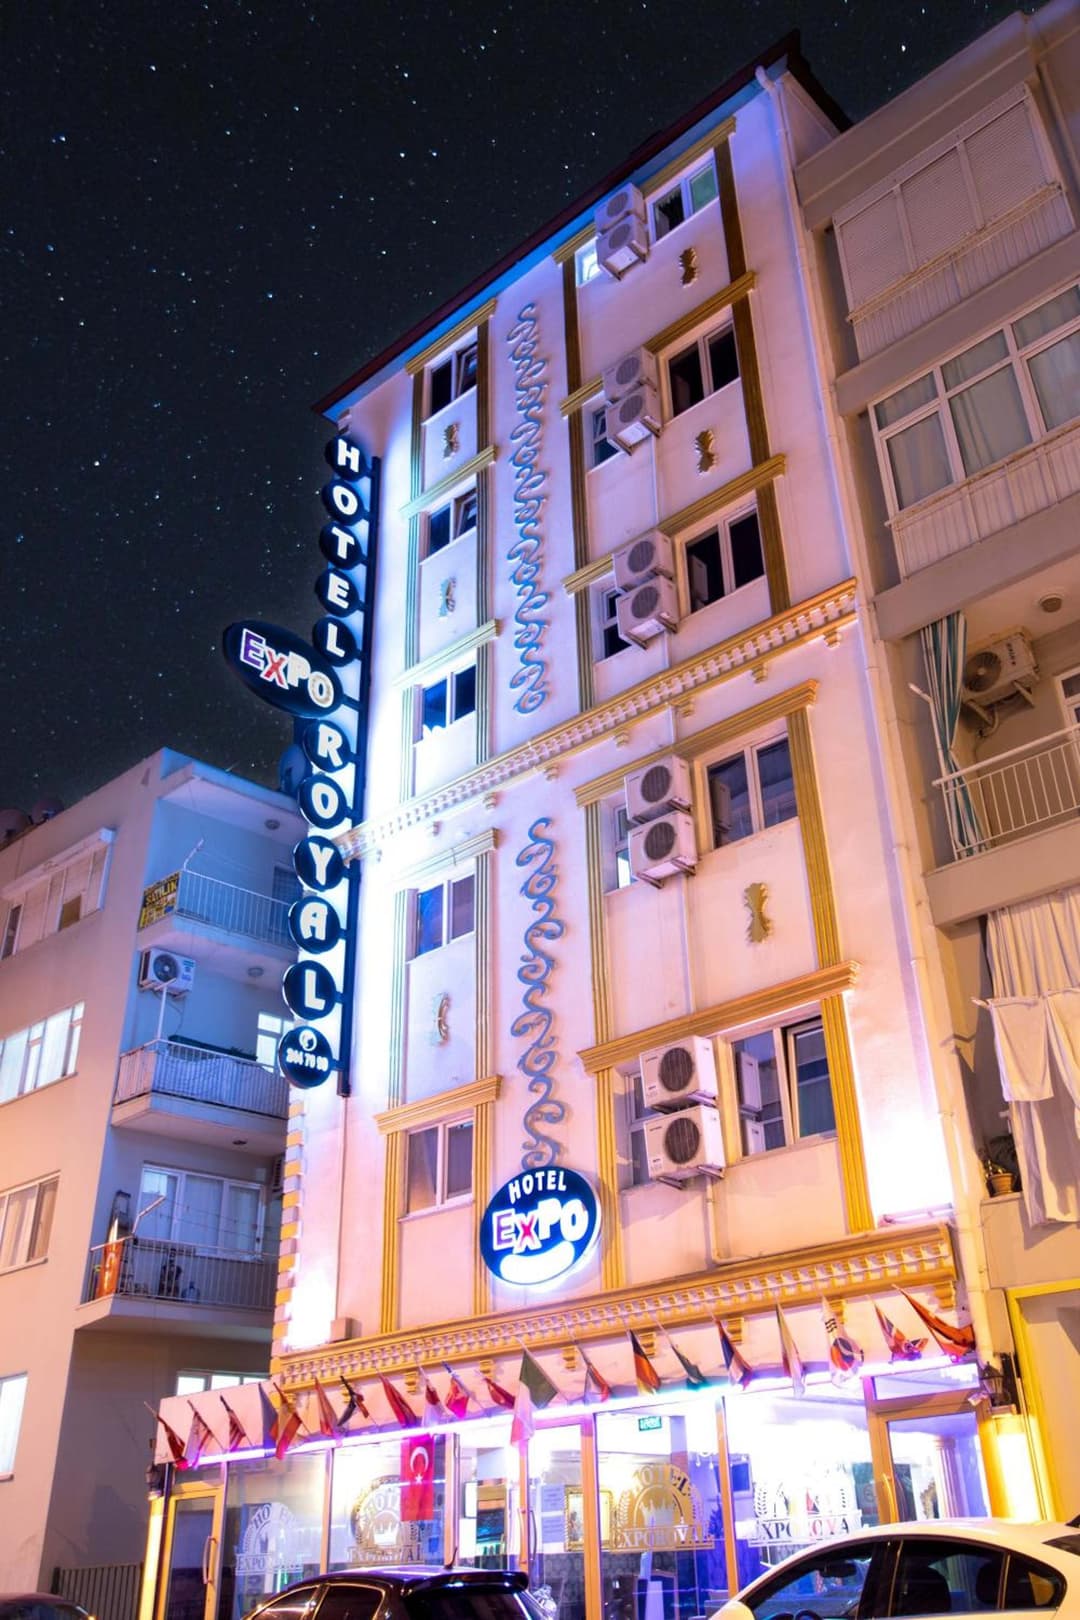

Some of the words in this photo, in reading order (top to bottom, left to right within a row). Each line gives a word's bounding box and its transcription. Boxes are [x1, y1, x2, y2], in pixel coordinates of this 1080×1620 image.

[326, 438, 360, 658] HOTEL
[239, 628, 334, 708] EXPO
[299, 723, 343, 1011] ROYAL
[492, 1198, 589, 1255] EXPO
[508, 1170, 567, 1204] HOTEL
